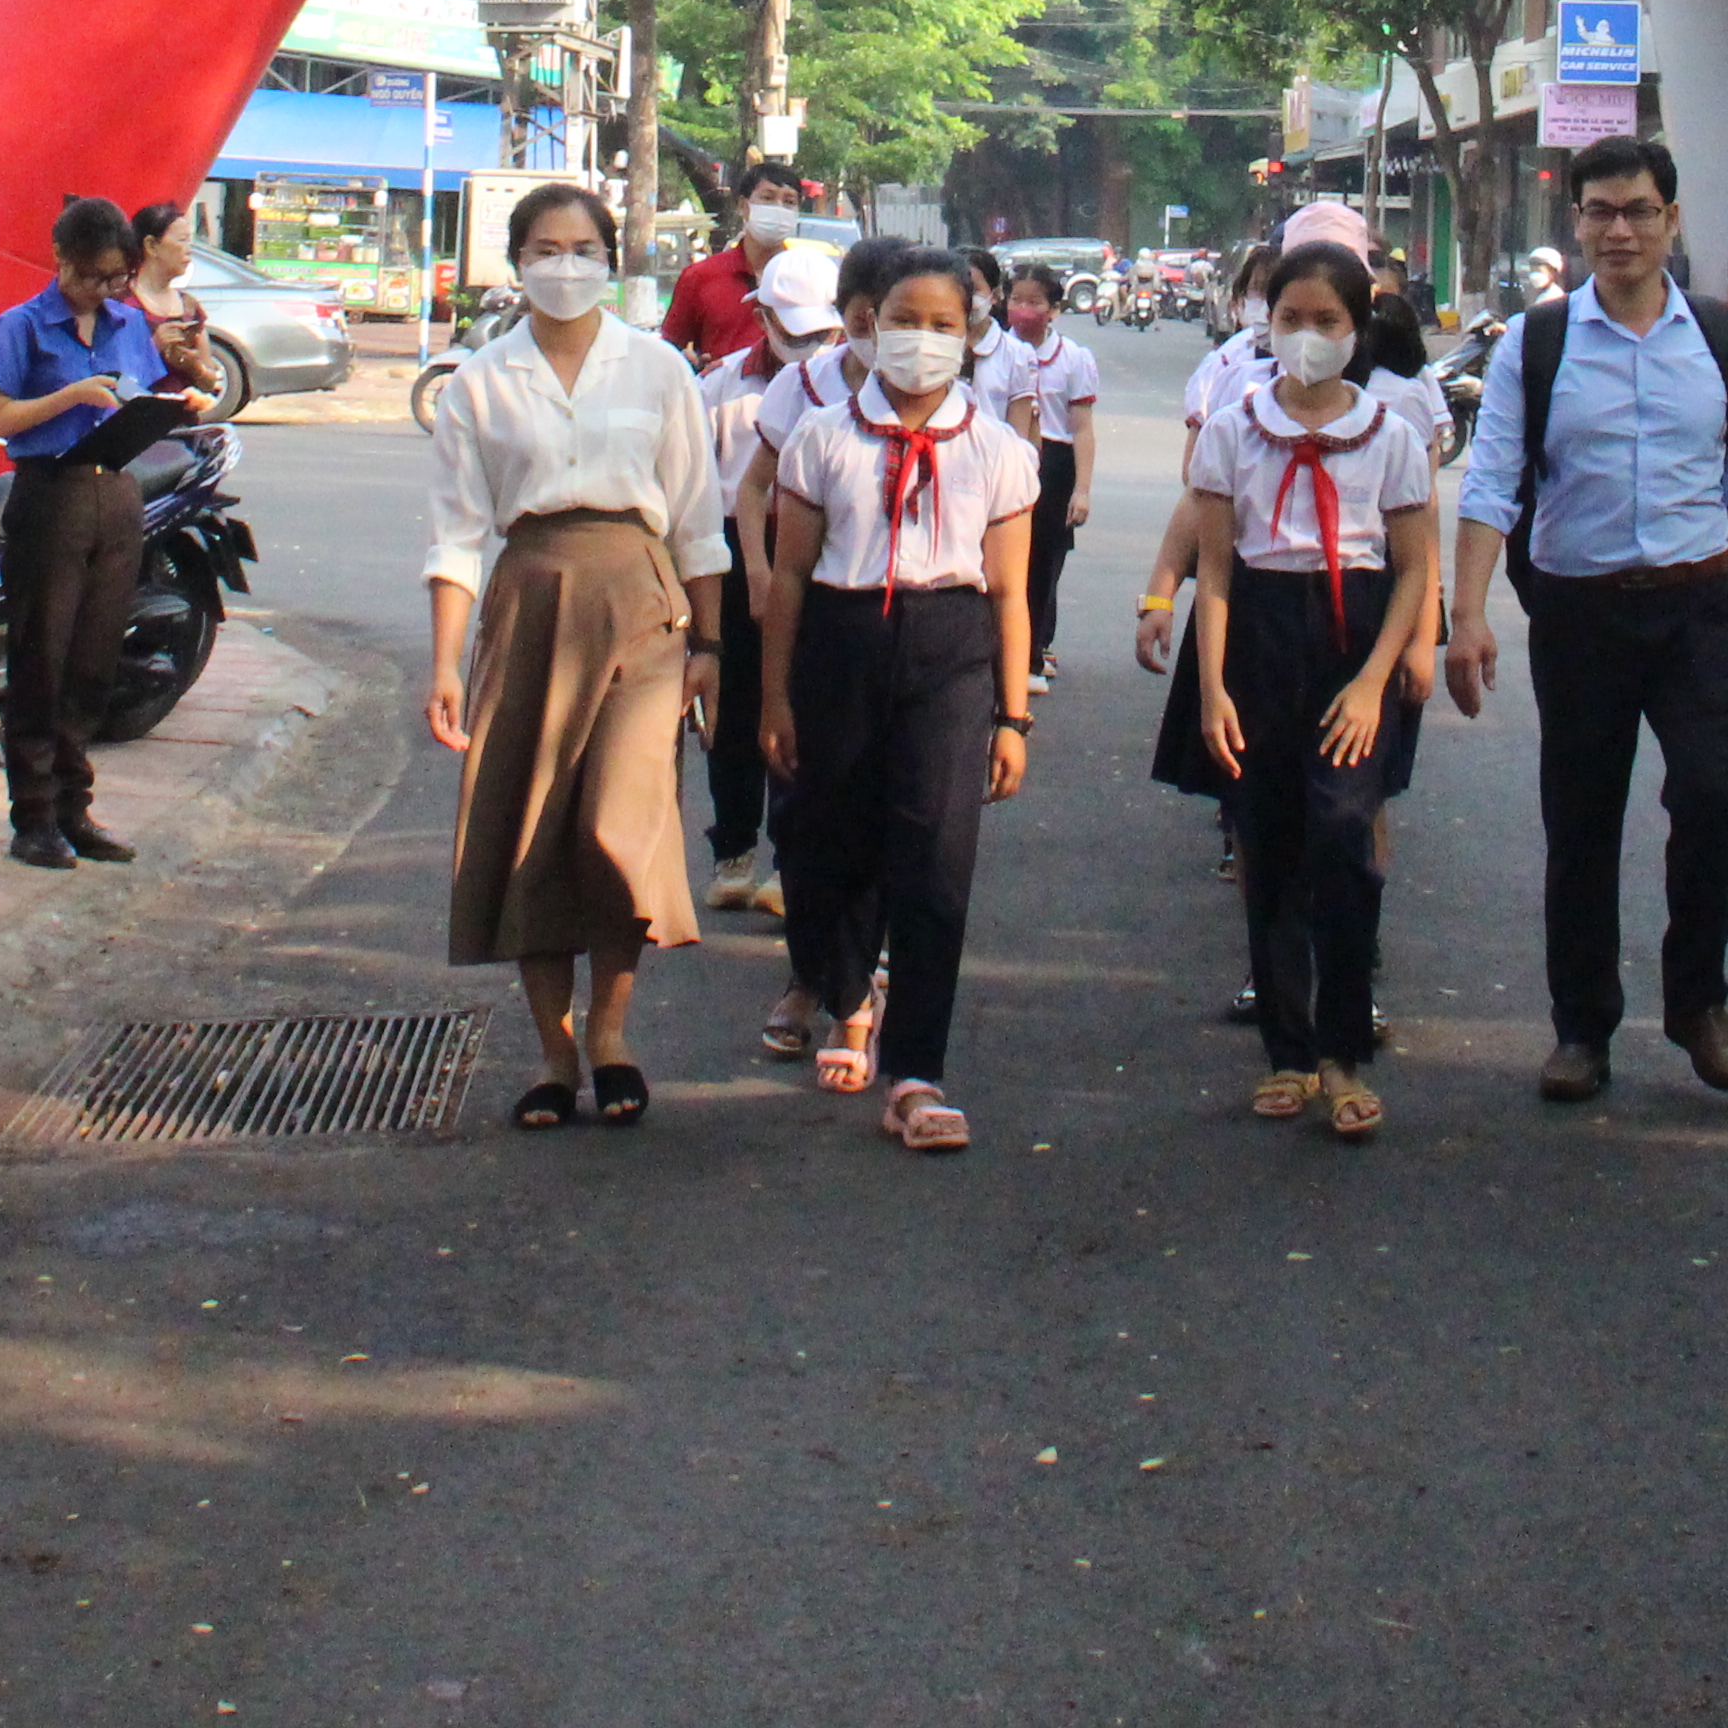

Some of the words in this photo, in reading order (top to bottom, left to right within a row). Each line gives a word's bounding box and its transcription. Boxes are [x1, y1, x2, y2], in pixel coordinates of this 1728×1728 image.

[1561, 47, 1636, 57] MICHELIN
[1560, 61, 1585, 71] CAR
[1586, 62, 1638, 72] SERVICE
